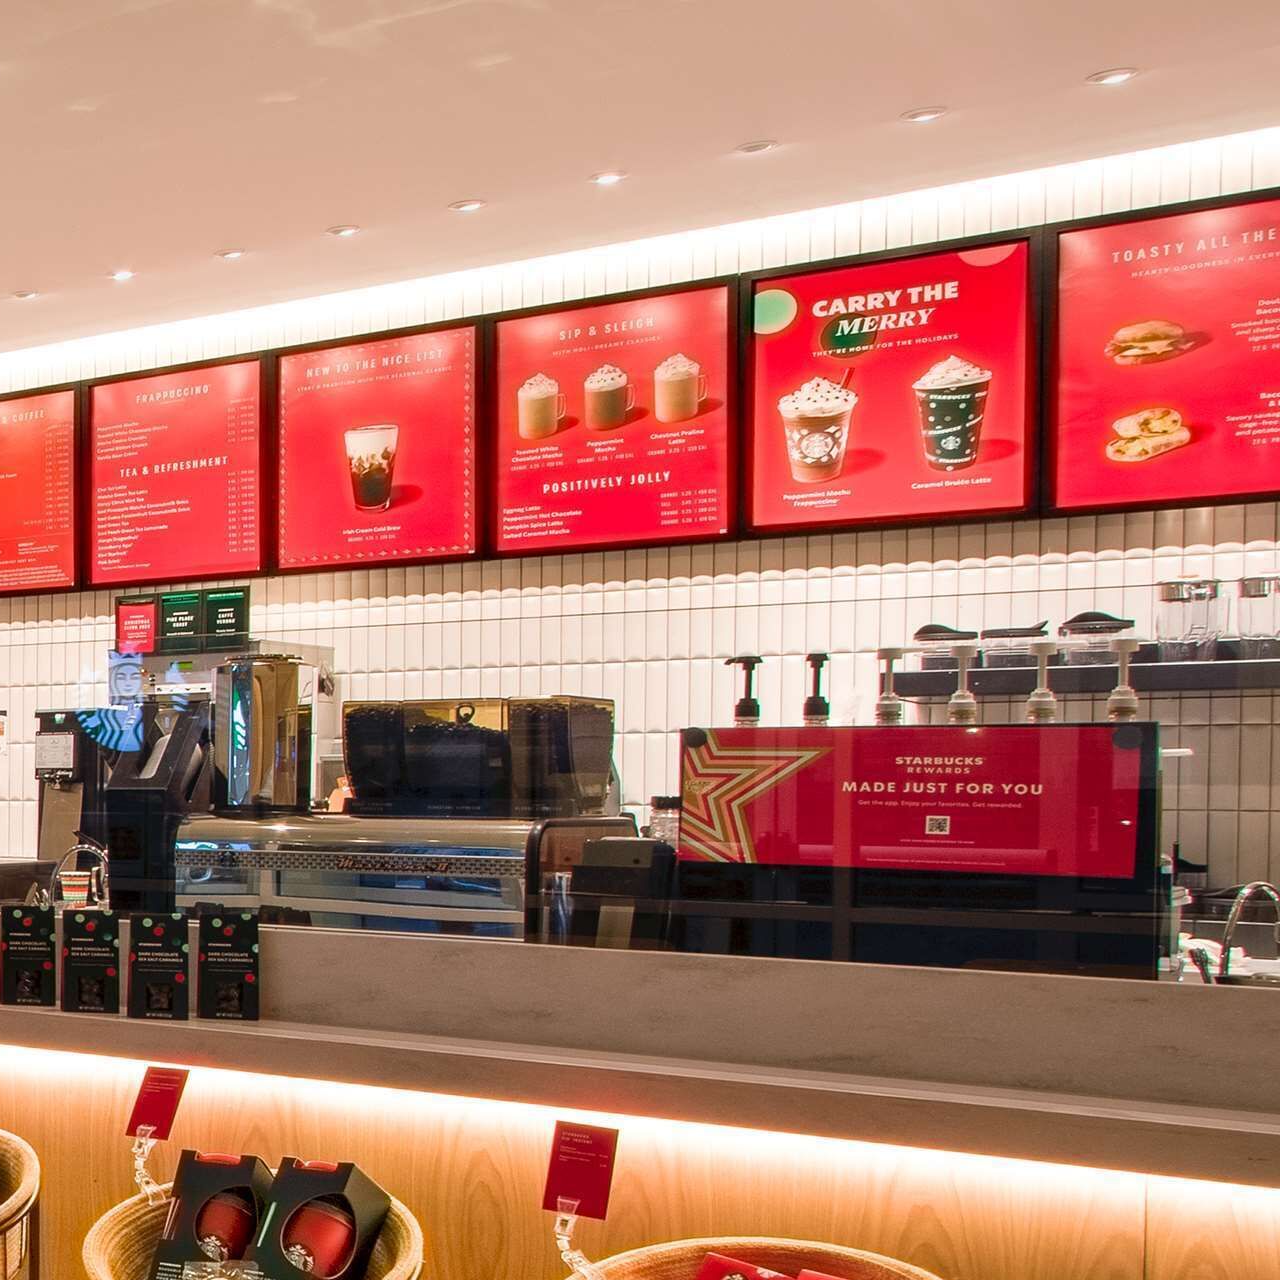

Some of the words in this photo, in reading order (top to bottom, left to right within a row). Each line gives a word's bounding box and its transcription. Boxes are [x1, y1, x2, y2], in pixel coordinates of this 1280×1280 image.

[1112, 242, 1185, 264] TOASTY
[1197, 236, 1230, 251] ALL
[1242, 228, 1277, 244] THE
[1173, 259, 1230, 272] GOODNESS
[812, 289, 902, 317] CARRY
[907, 281, 959, 304] THE
[559, 329, 581, 340] SIP
[589, 326, 597, 335] &
[605, 318, 654, 333] SLEIGH
[835, 307, 936, 337] MERRY
[812, 347, 846, 358] THEY'RE
[849, 344, 874, 352] HOME
[915, 333, 959, 344] HOLIDAYS
[306, 366, 330, 377] NEW
[336, 363, 349, 373] TO
[356, 359, 376, 370] THE
[382, 355, 409, 366] NICE
[416, 349, 443, 361] LIST
[136, 384, 209, 404] FRAPPUCCINO
[587, 437, 624, 447] Peppermint
[668, 437, 686, 445] Latte
[594, 446, 616, 454] Mocha
[120, 468, 137, 477] TEA
[142, 466, 149, 475] &
[154, 456, 228, 474] REFRESHMENT
[543, 476, 623, 494] POSITIVELY
[630, 471, 671, 485] JOLLY
[911, 480, 943, 490] Caramel
[971, 476, 992, 485] Latte
[783, 489, 826, 501] Peppermint
[827, 488, 851, 498] Mocha
[895, 756, 984, 765] STARBUCKS
[841, 781, 896, 793] MADE
[903, 782, 948, 794] JUST
[955, 783, 994, 794] FOR
[1001, 784, 1044, 795] YOU
[884, 800, 899, 808] app.
[901, 800, 919, 808] Enjoy
